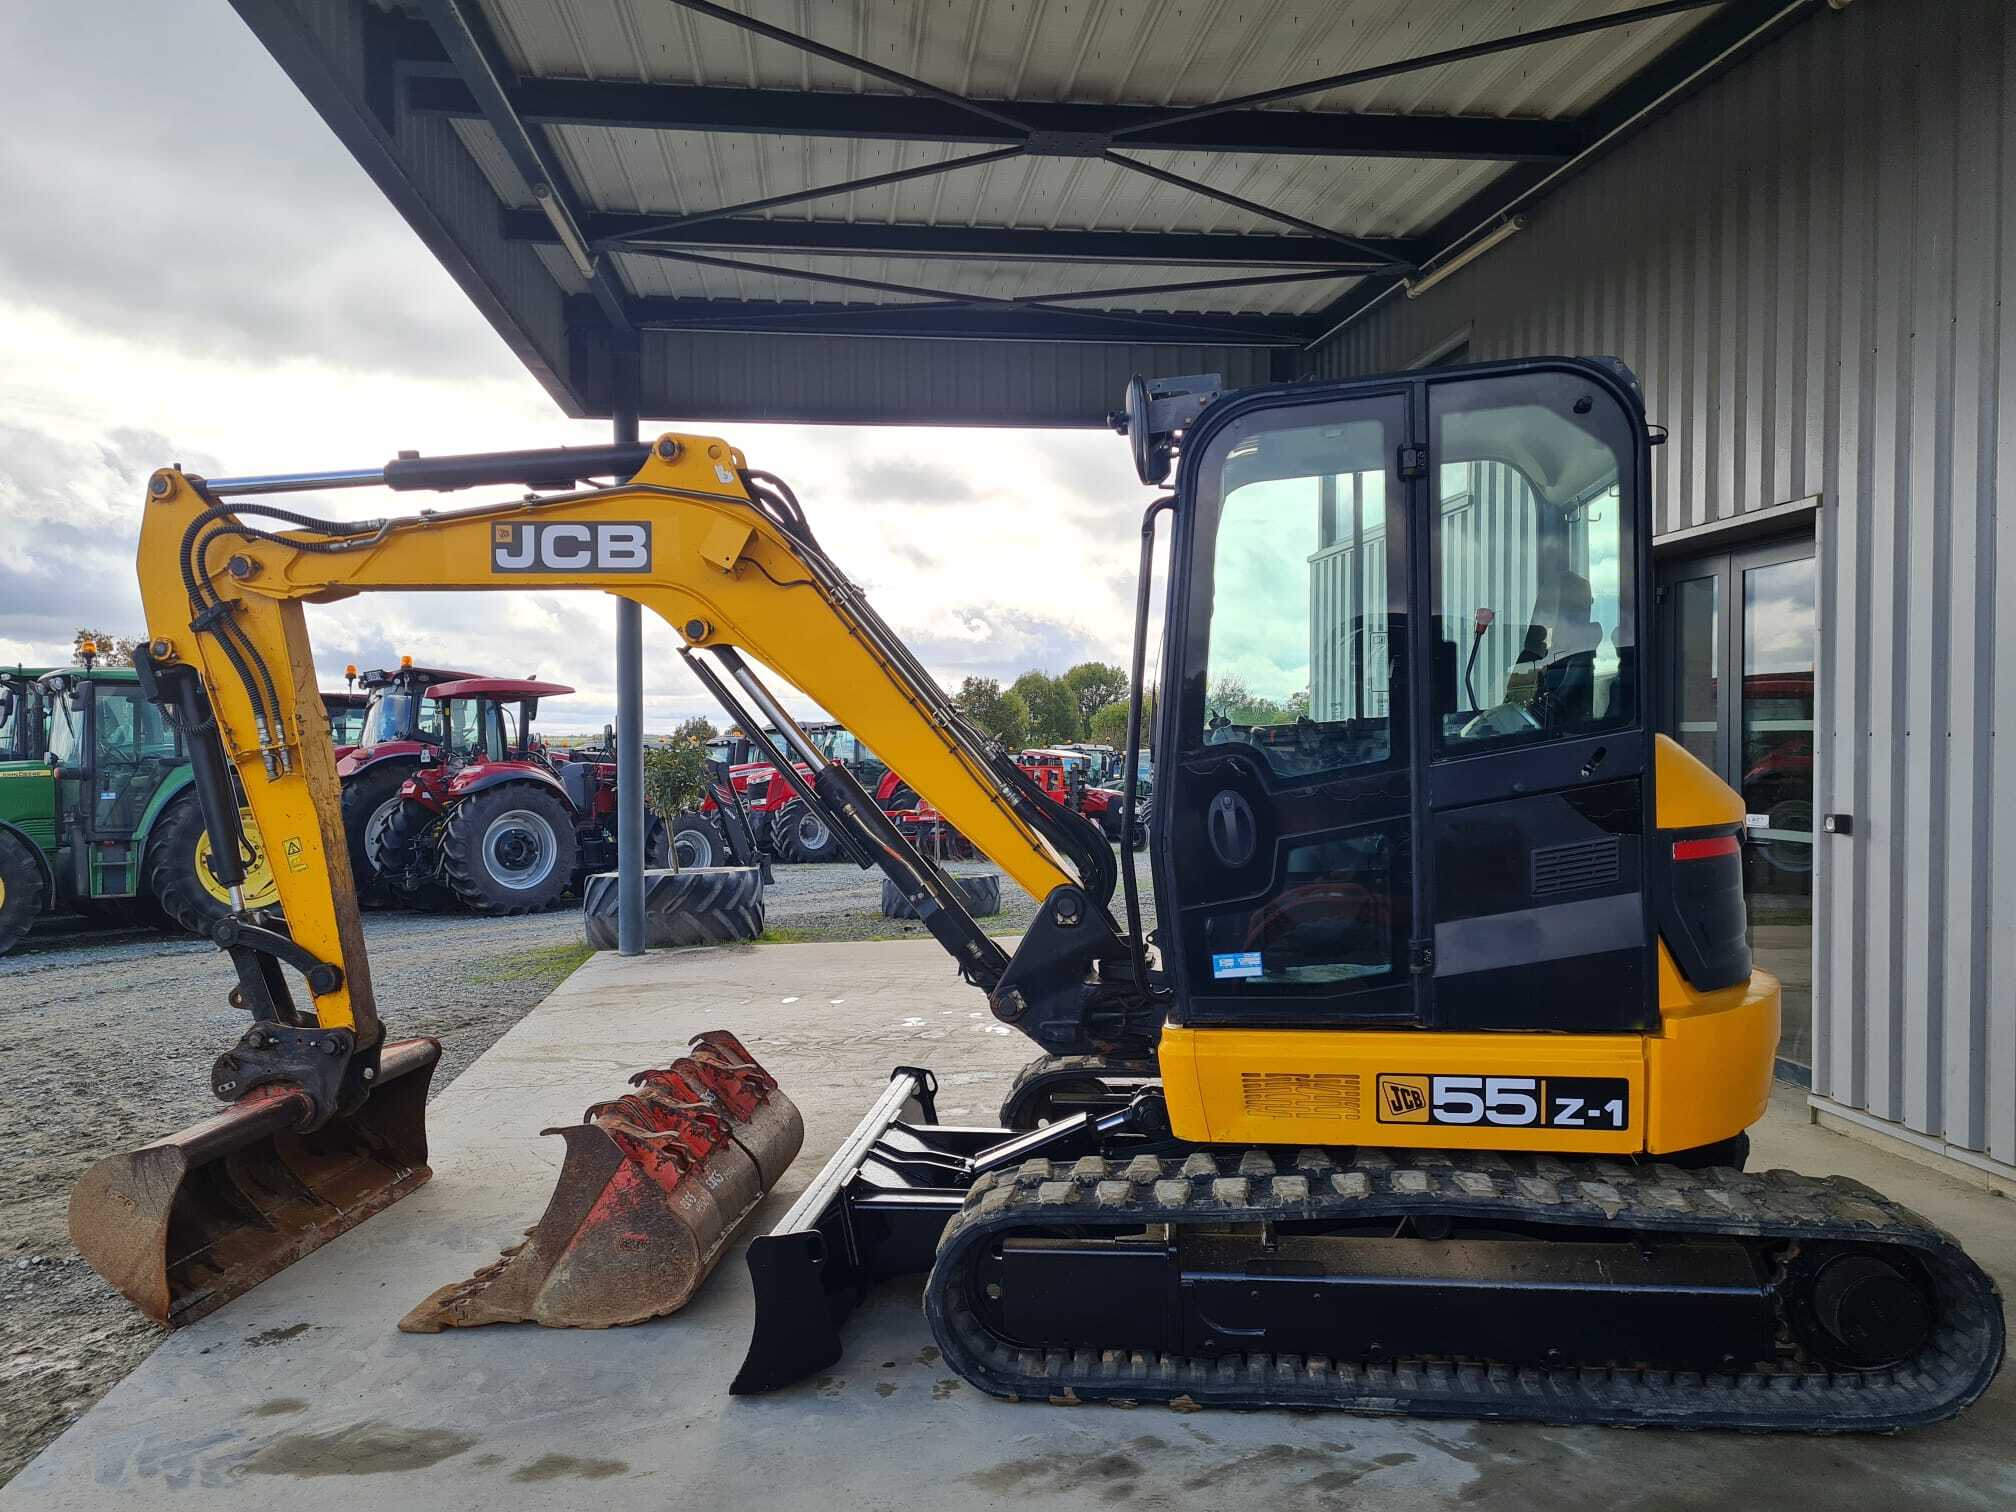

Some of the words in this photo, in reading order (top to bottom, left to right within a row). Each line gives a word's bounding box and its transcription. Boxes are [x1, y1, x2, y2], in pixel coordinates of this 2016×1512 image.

[496, 525, 648, 568] JCB
[1390, 1085, 1426, 1112] JCB
[1433, 1076, 1538, 1125] 55
[1553, 1098, 1623, 1127] Z-1
